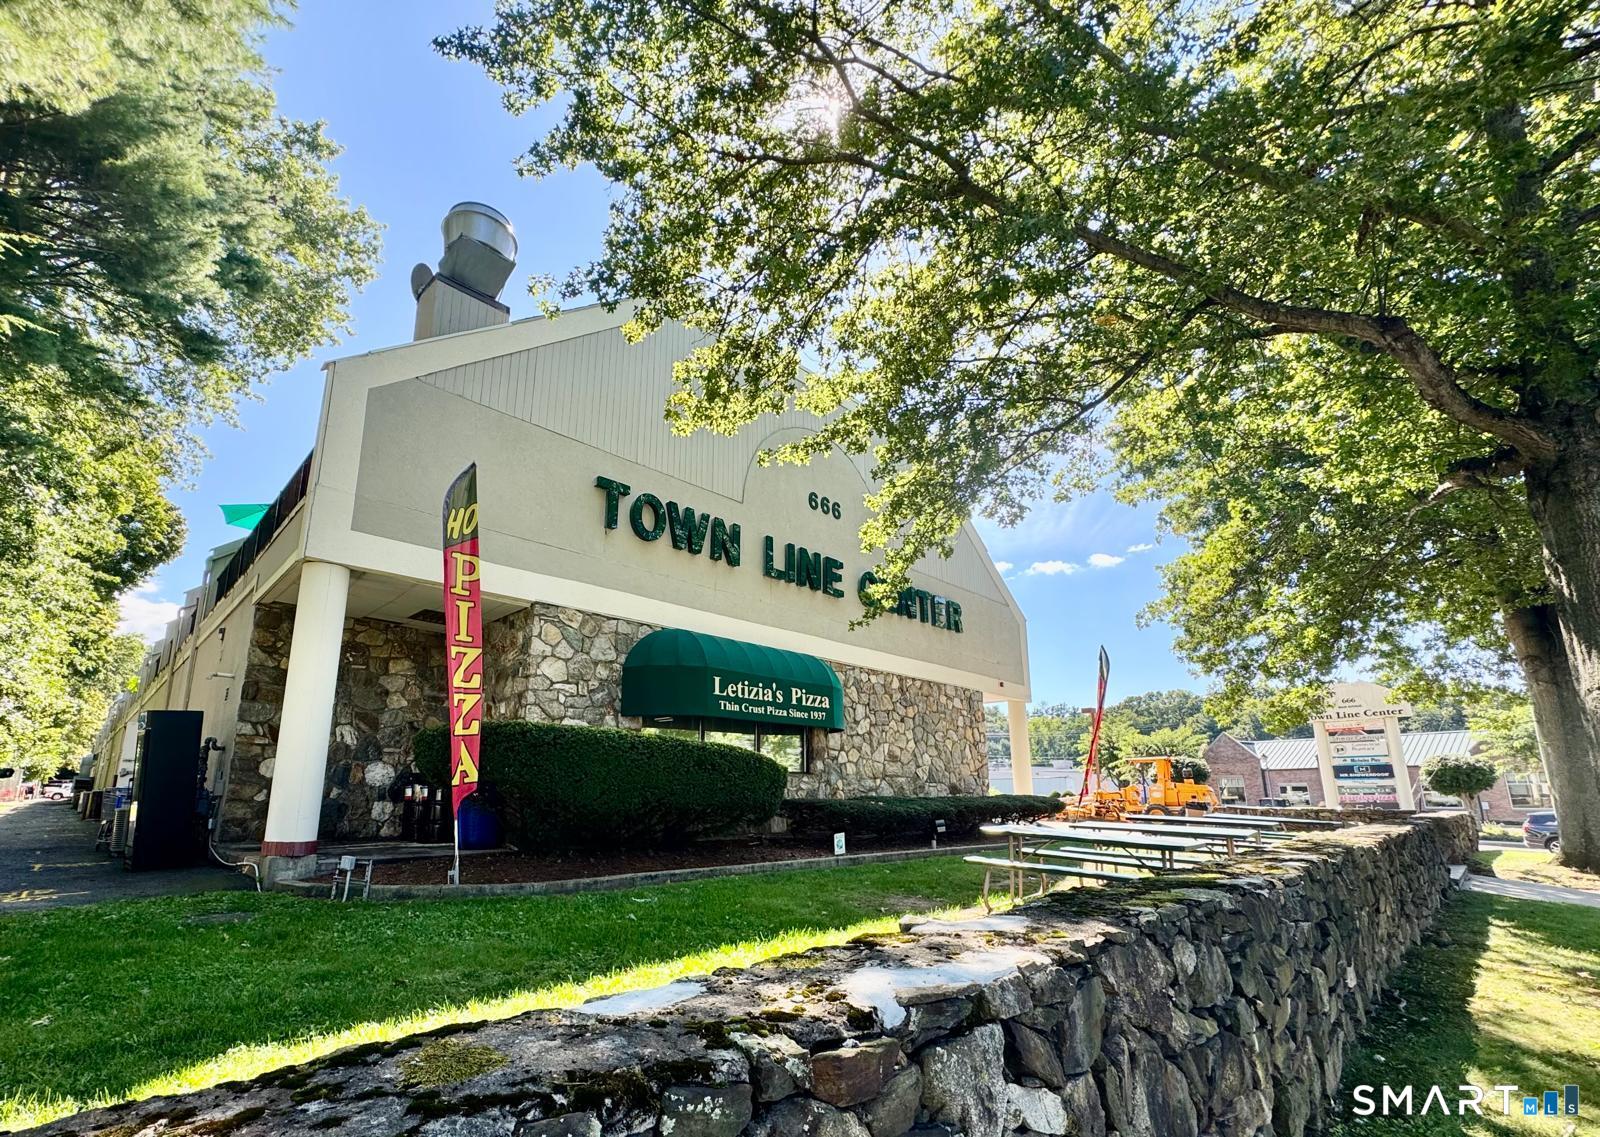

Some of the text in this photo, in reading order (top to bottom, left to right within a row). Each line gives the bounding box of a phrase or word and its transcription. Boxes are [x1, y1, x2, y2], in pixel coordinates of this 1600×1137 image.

[808, 491, 842, 520] 666
[594, 475, 963, 633] TOWN LINE CNTER
[450, 551, 483, 786] PIZZA
[713, 676, 830, 709] Letizia's Pizza
[719, 700, 826, 720] Thin Crust Pizza Since 1937
[1310, 708, 1404, 721] own Line Center
